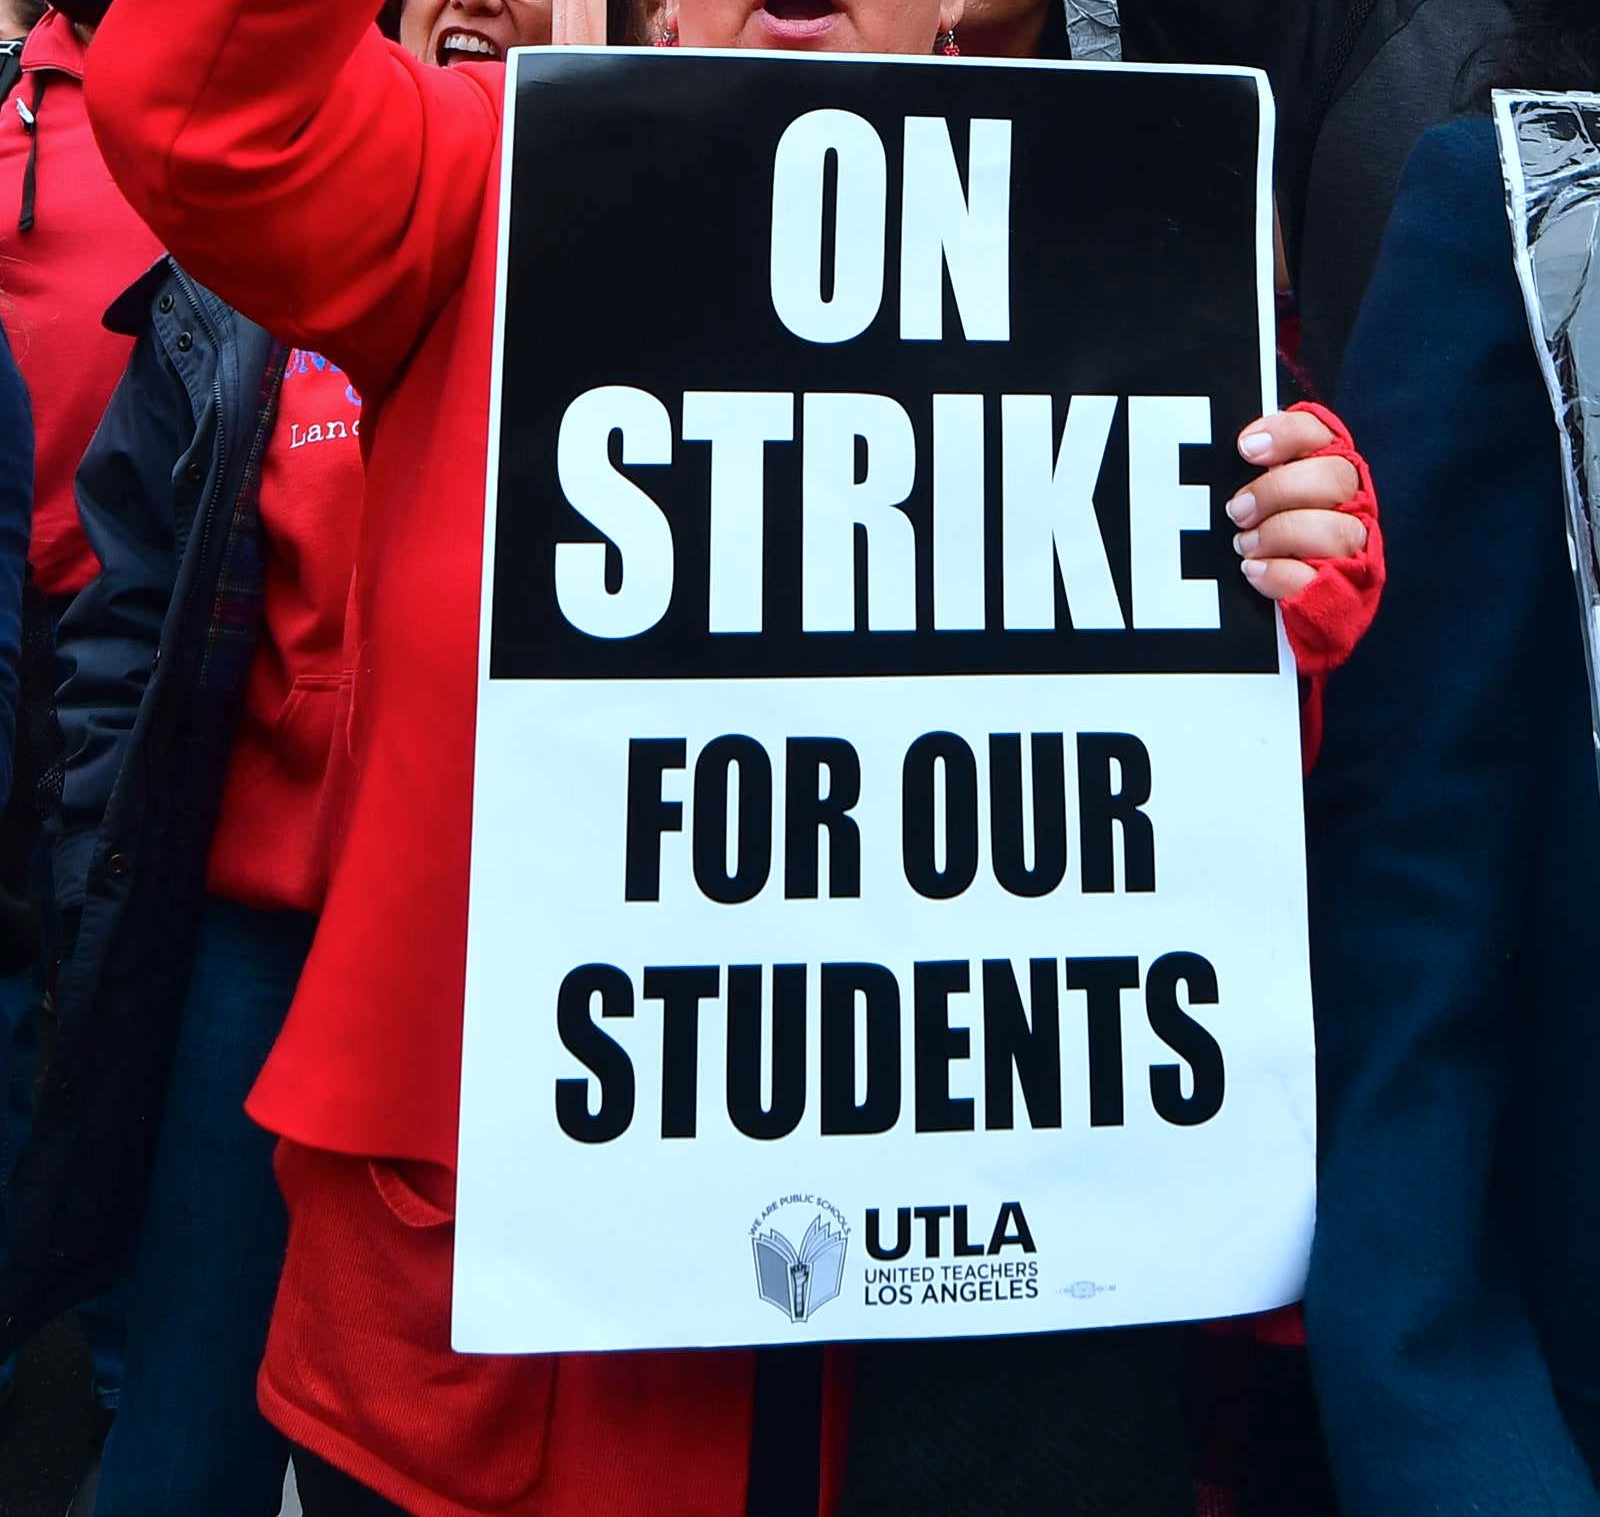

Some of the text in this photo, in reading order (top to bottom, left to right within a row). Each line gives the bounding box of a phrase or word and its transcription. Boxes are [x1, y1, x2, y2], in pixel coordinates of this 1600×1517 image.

[770, 106, 1012, 344] ON
[555, 384, 1220, 639] STRIKE
[624, 730, 1156, 904] FOR OUR
[555, 951, 1225, 1143] STUDENTS
[779, 1194, 814, 1208] PUBLIC
[816, 1196, 851, 1236] SCHOOLS
[865, 1201, 1037, 1261] UTLA
[865, 1261, 1038, 1283] UNITED TEACHERS
[865, 1285, 913, 1306] LOS
[921, 1279, 1039, 1304] ANGELES
